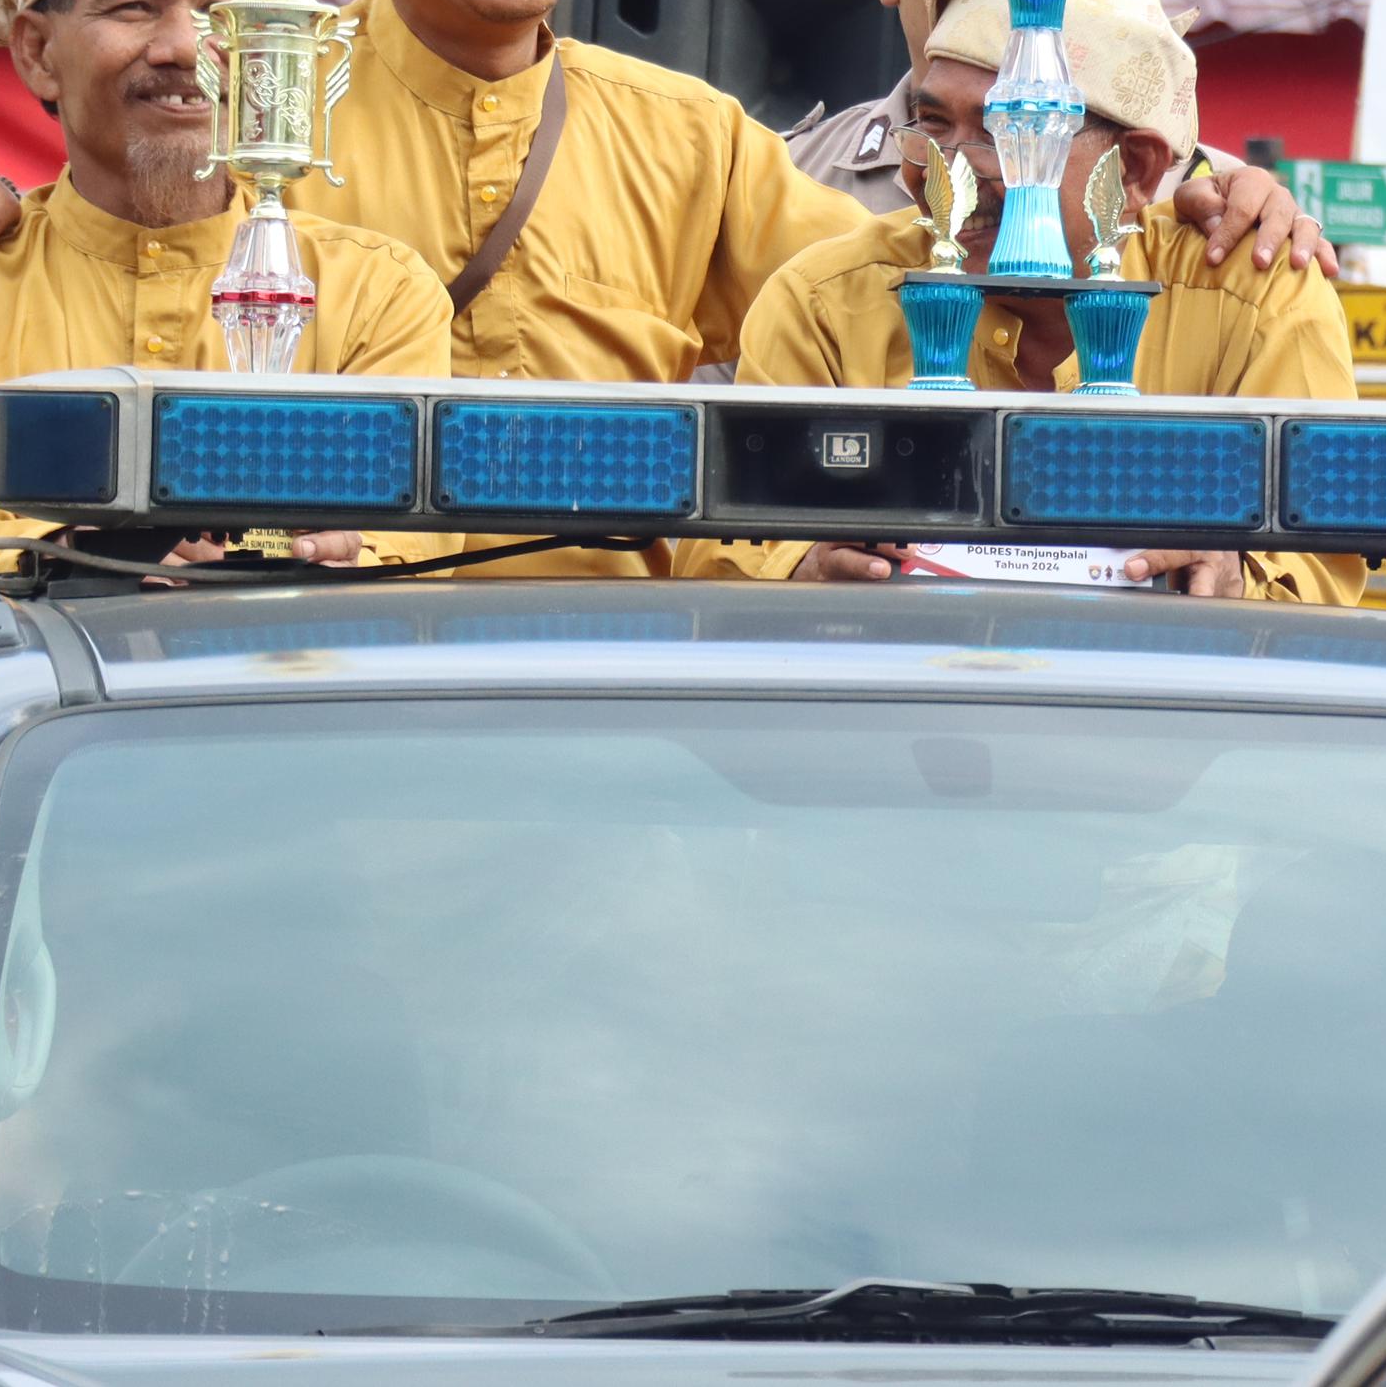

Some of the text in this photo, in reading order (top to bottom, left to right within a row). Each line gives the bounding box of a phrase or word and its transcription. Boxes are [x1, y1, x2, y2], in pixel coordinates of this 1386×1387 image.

[250, 540, 275, 549] SUMATRA
[967, 545, 1088, 560] POLRES Tanjungbalai
[995, 560, 1060, 571] Tahun 2024
